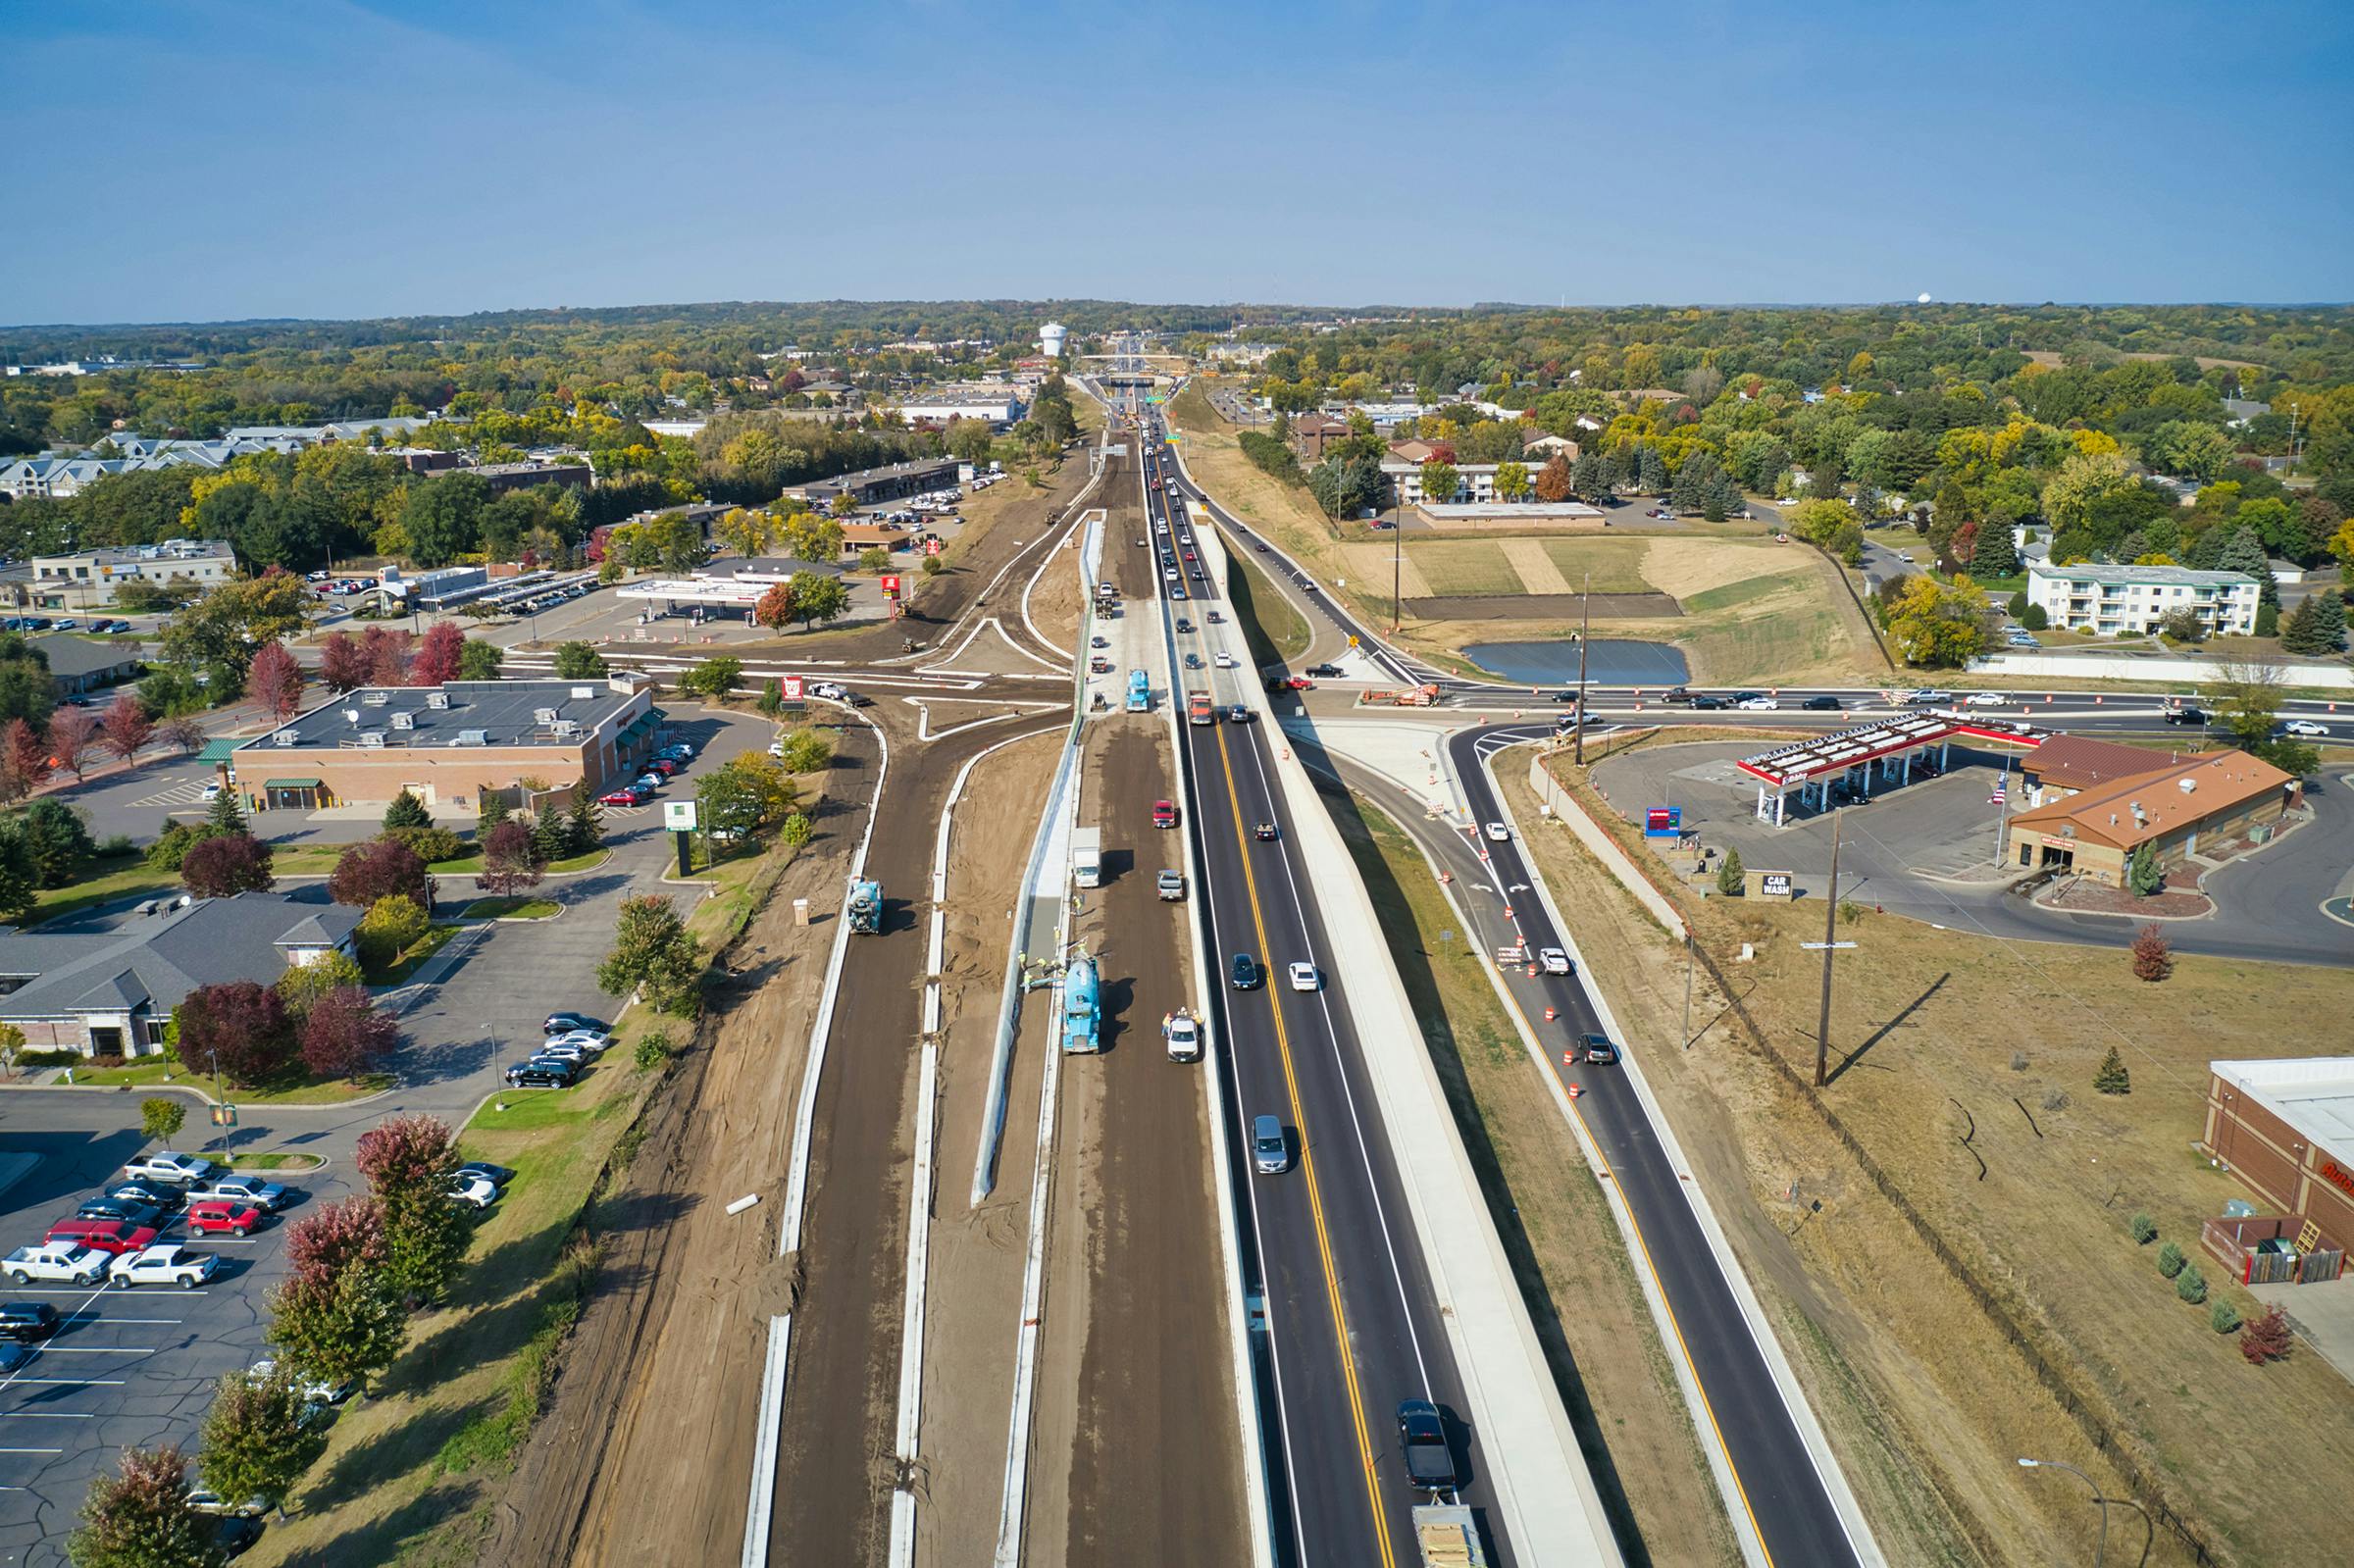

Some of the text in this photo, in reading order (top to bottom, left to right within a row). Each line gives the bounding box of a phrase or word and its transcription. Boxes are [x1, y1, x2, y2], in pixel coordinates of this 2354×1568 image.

[1767, 877, 1786, 885] CAR
[1764, 885, 1790, 895] WASH
[2322, 1161, 2354, 1198] Auto
